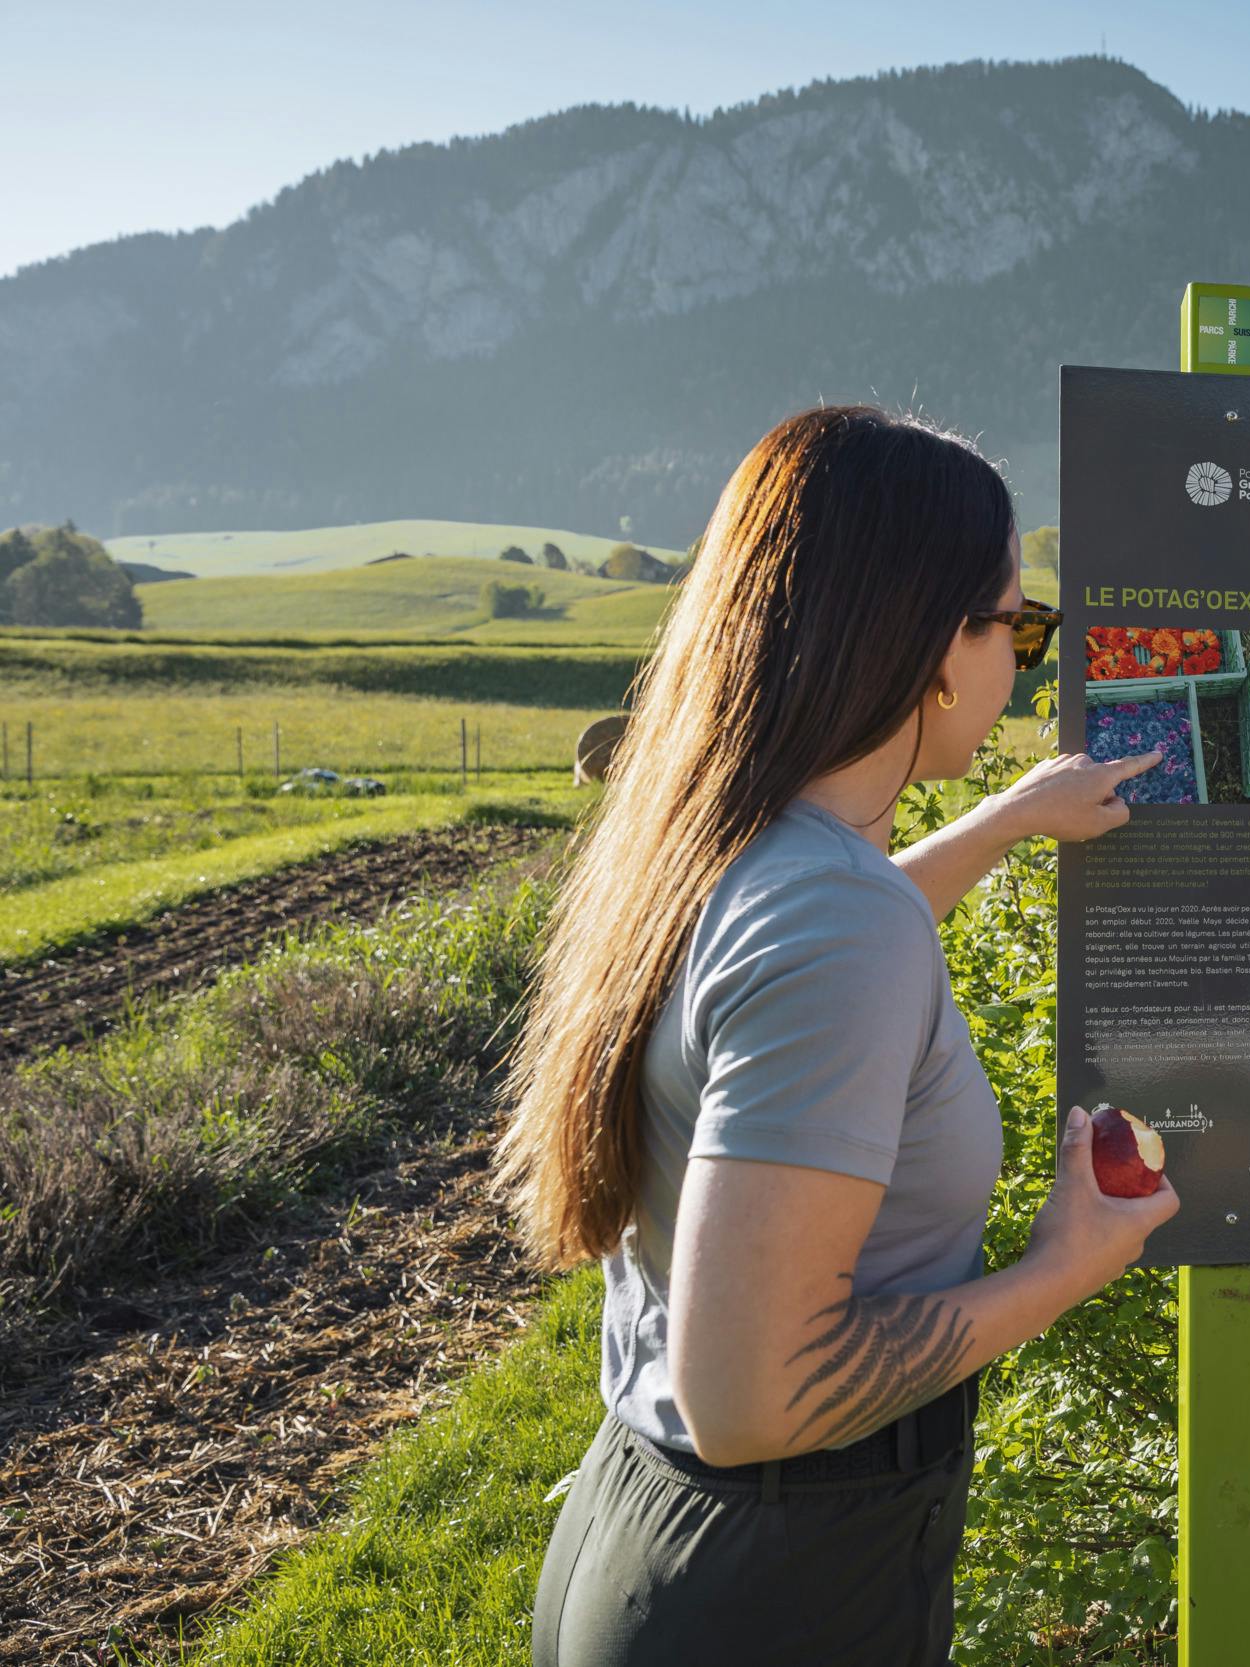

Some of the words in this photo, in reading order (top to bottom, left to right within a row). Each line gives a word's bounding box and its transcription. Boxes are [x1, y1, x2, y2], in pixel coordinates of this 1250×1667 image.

[1199, 325, 1224, 335] PARCS
[1085, 586, 1114, 607] LE
[1155, 907, 1169, 915] jour
[1181, 905, 1200, 913] 2020.
[1201, 905, 1221, 915] Après
[1222, 905, 1240, 913] avoir
[1103, 918, 1126, 928] emploi
[1131, 918, 1151, 926] début
[1225, 917, 1249, 925] décide
[1120, 930, 1132, 938] elle
[1143, 930, 1169, 938] cultiver
[1172, 930, 1184, 938] des
[1185, 929, 1216, 940] légumes.
[1218, 929, 1230, 937] Les
[1085, 955, 1109, 965] depuis
[1112, 955, 1125, 963] des
[1127, 954, 1152, 963] années
[1169, 954, 1197, 962] Moulins
[1199, 956, 1211, 964] par
[1221, 954, 1245, 962] famille
[1085, 967, 1096, 977] qui
[1100, 967, 1132, 977] privilégie
[1135, 967, 1145, 975] les
[1148, 966, 1187, 977] techniques
[1191, 966, 1203, 974] bio.
[1206, 966, 1232, 974] Bastien
[1086, 980, 1109, 990] rejoint
[1110, 980, 1151, 990] rapidement
[1153, 979, 1189, 988] l'aventure.
[1149, 1119, 1200, 1129] SAVURANDO
